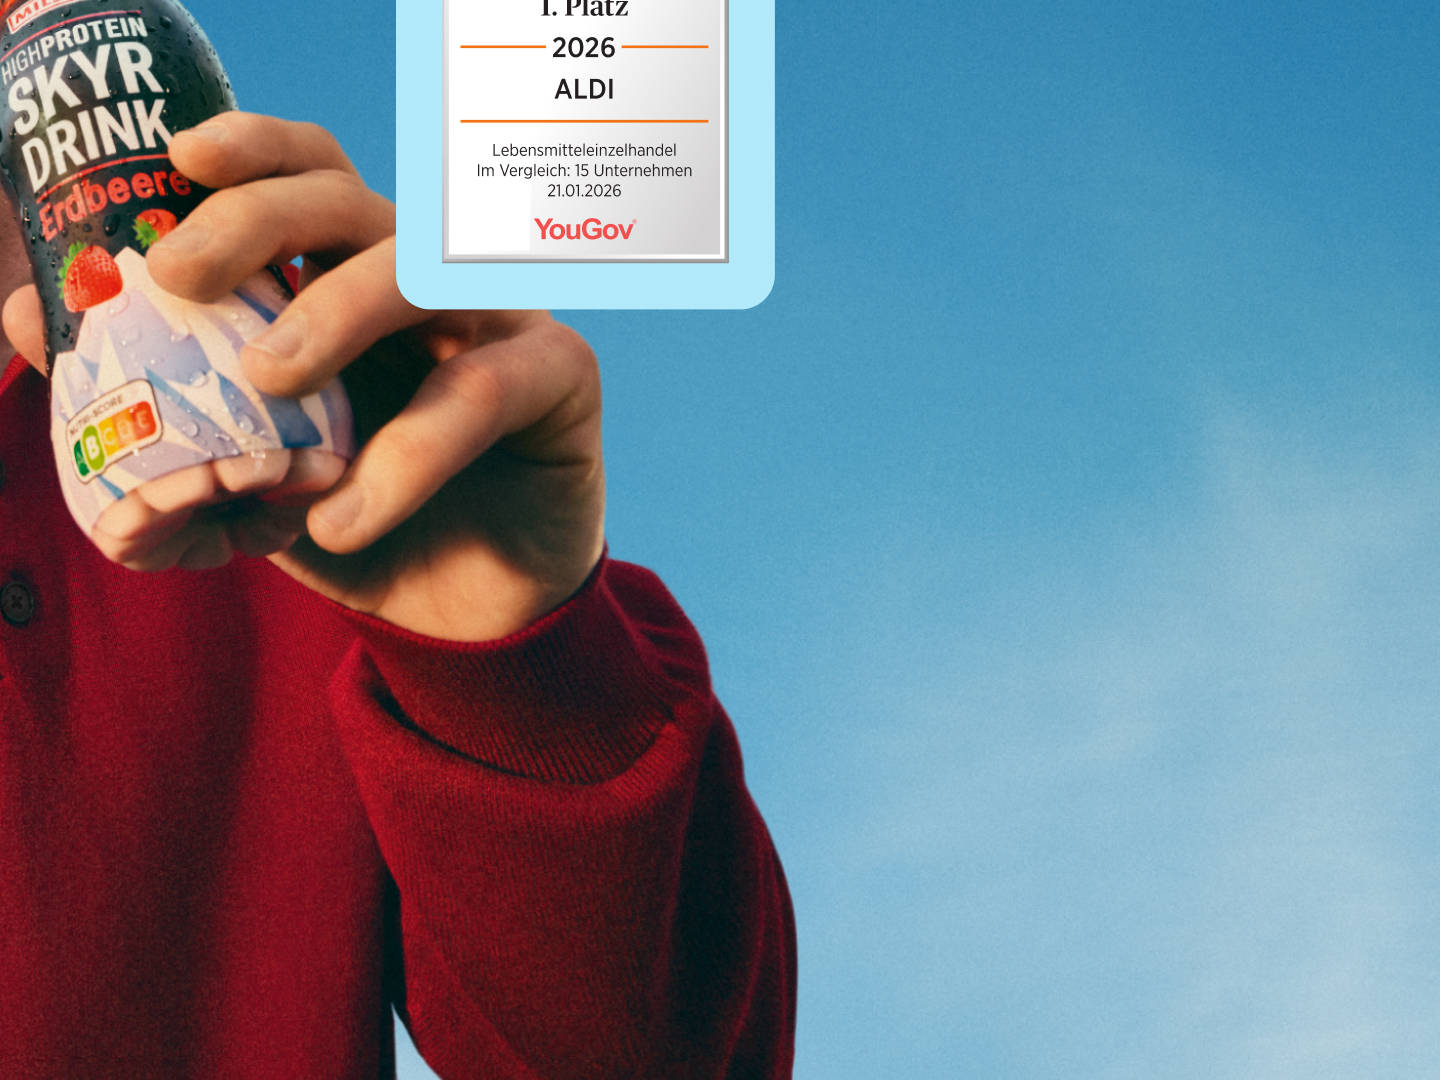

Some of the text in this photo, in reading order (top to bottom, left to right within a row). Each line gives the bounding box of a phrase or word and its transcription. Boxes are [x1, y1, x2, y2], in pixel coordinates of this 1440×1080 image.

[8, 41, 164, 135] SKYR
[21, 99, 174, 193] DRINK
[39, 170, 191, 242] Erdbeere
[85, 435, 100, 460] B
